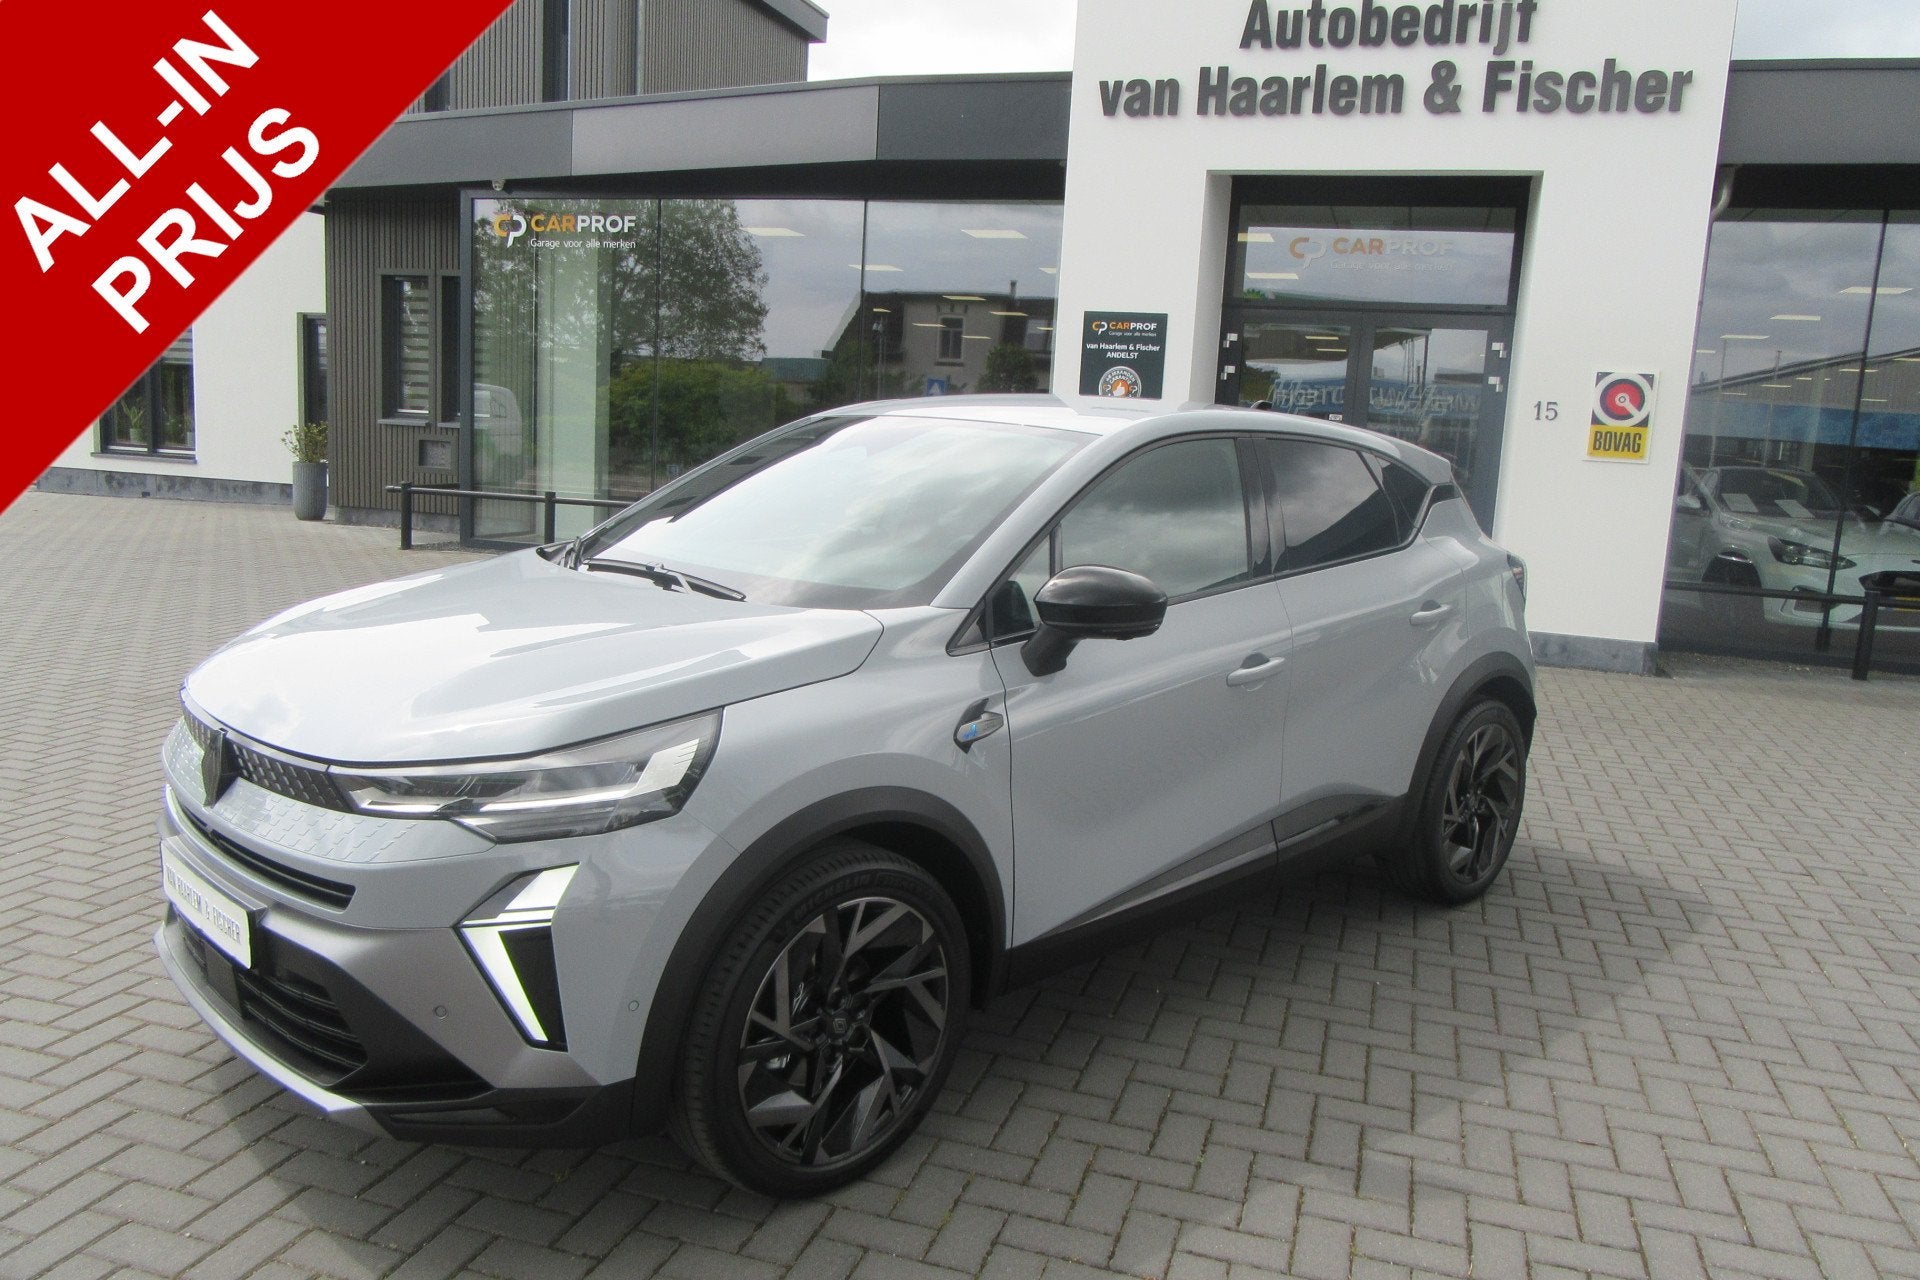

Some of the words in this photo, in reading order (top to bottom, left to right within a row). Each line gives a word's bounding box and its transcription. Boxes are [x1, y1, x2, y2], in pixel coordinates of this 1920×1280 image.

[1099, 77, 1181, 117] van
[1196, 64, 1404, 116] Haarlem
[1423, 60, 1462, 114] &
[1482, 58, 1694, 113] Fischer
[530, 214, 636, 233] CARPROF
[530, 238, 560, 249] Garage
[563, 240, 582, 248] voor
[586, 238, 600, 248] alle
[603, 239, 636, 248] merken
[1109, 322, 1157, 331] CARPROF
[1136, 344, 1160, 352] Fischer
[1534, 400, 1558, 421] 15
[1592, 430, 1642, 453] BOVAG
